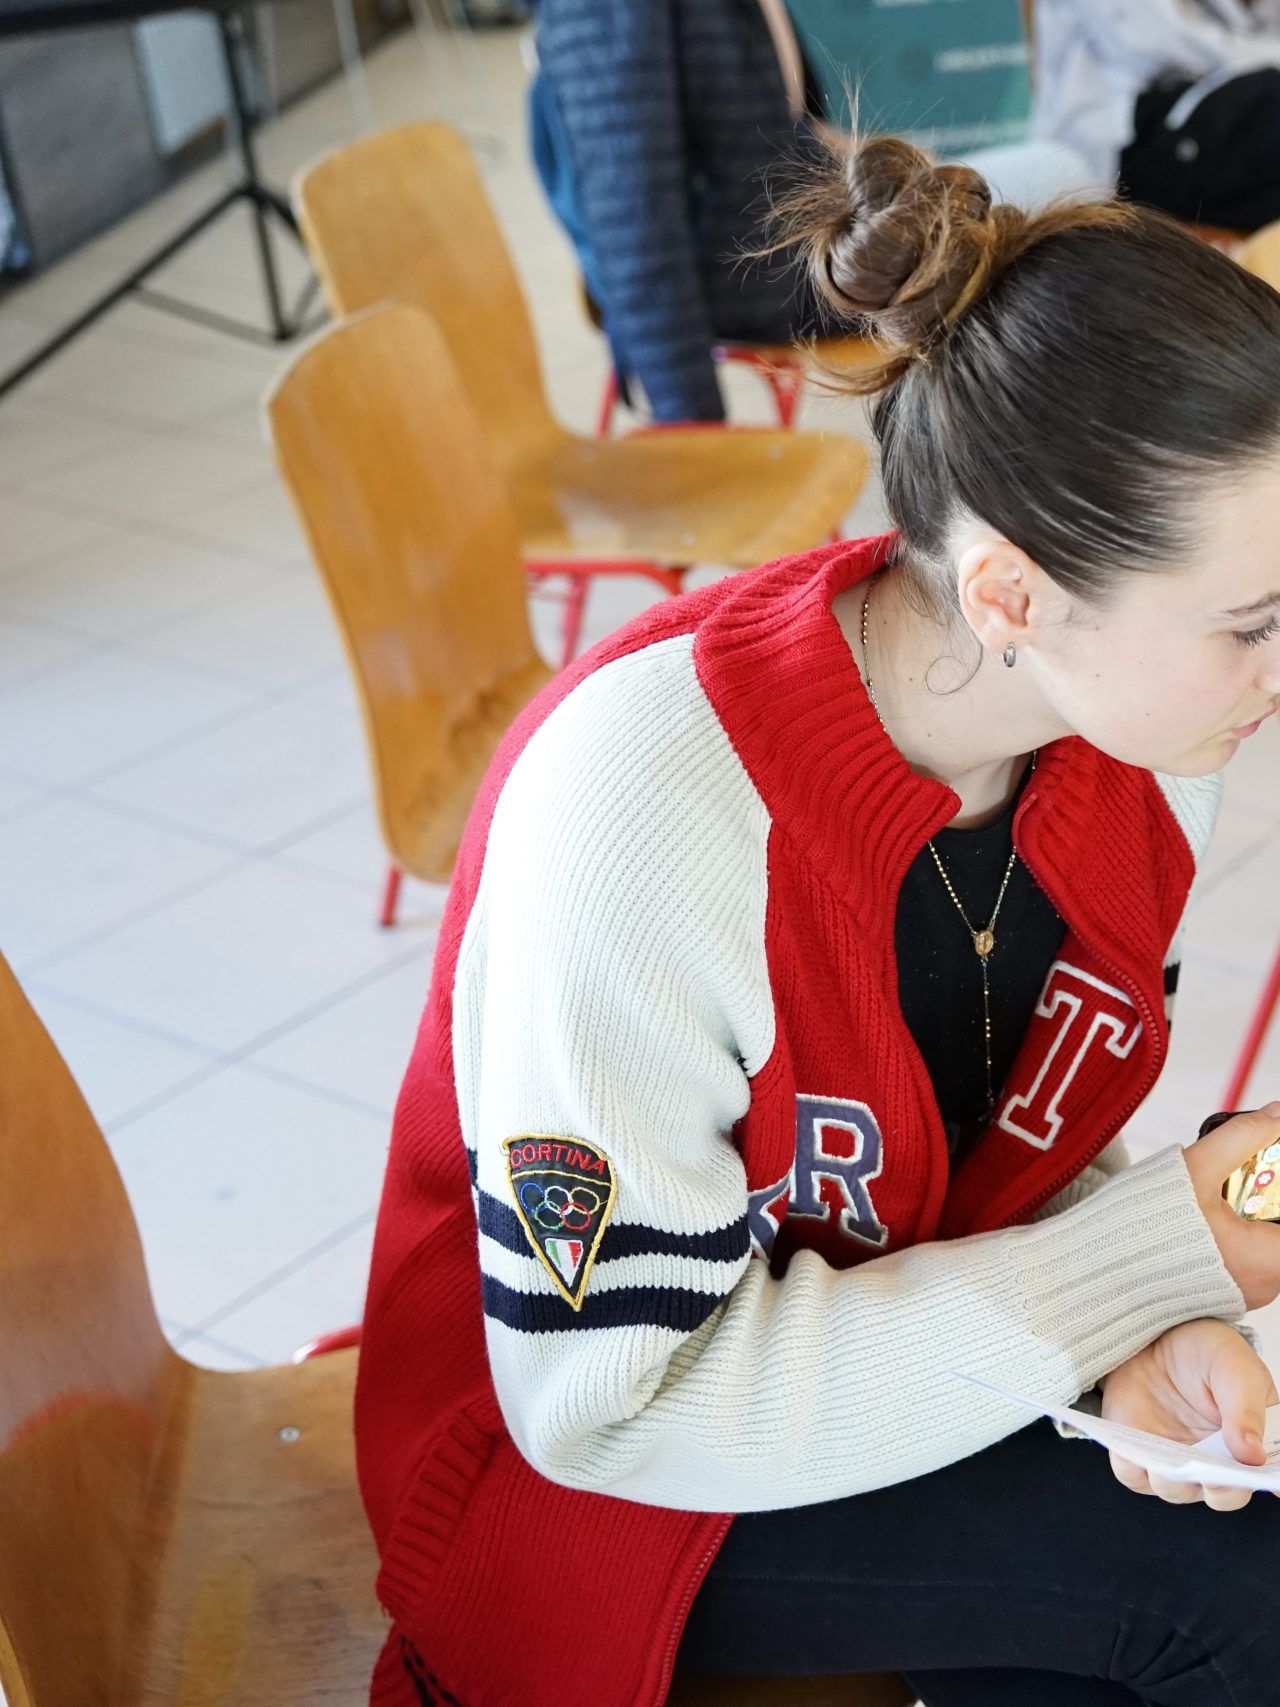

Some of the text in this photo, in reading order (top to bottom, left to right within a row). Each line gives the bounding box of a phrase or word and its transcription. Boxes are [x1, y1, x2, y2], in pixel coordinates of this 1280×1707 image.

[999, 960, 1144, 1151] T
[510, 1143, 607, 1176] CORTINA
[788, 1093, 888, 1248] R
